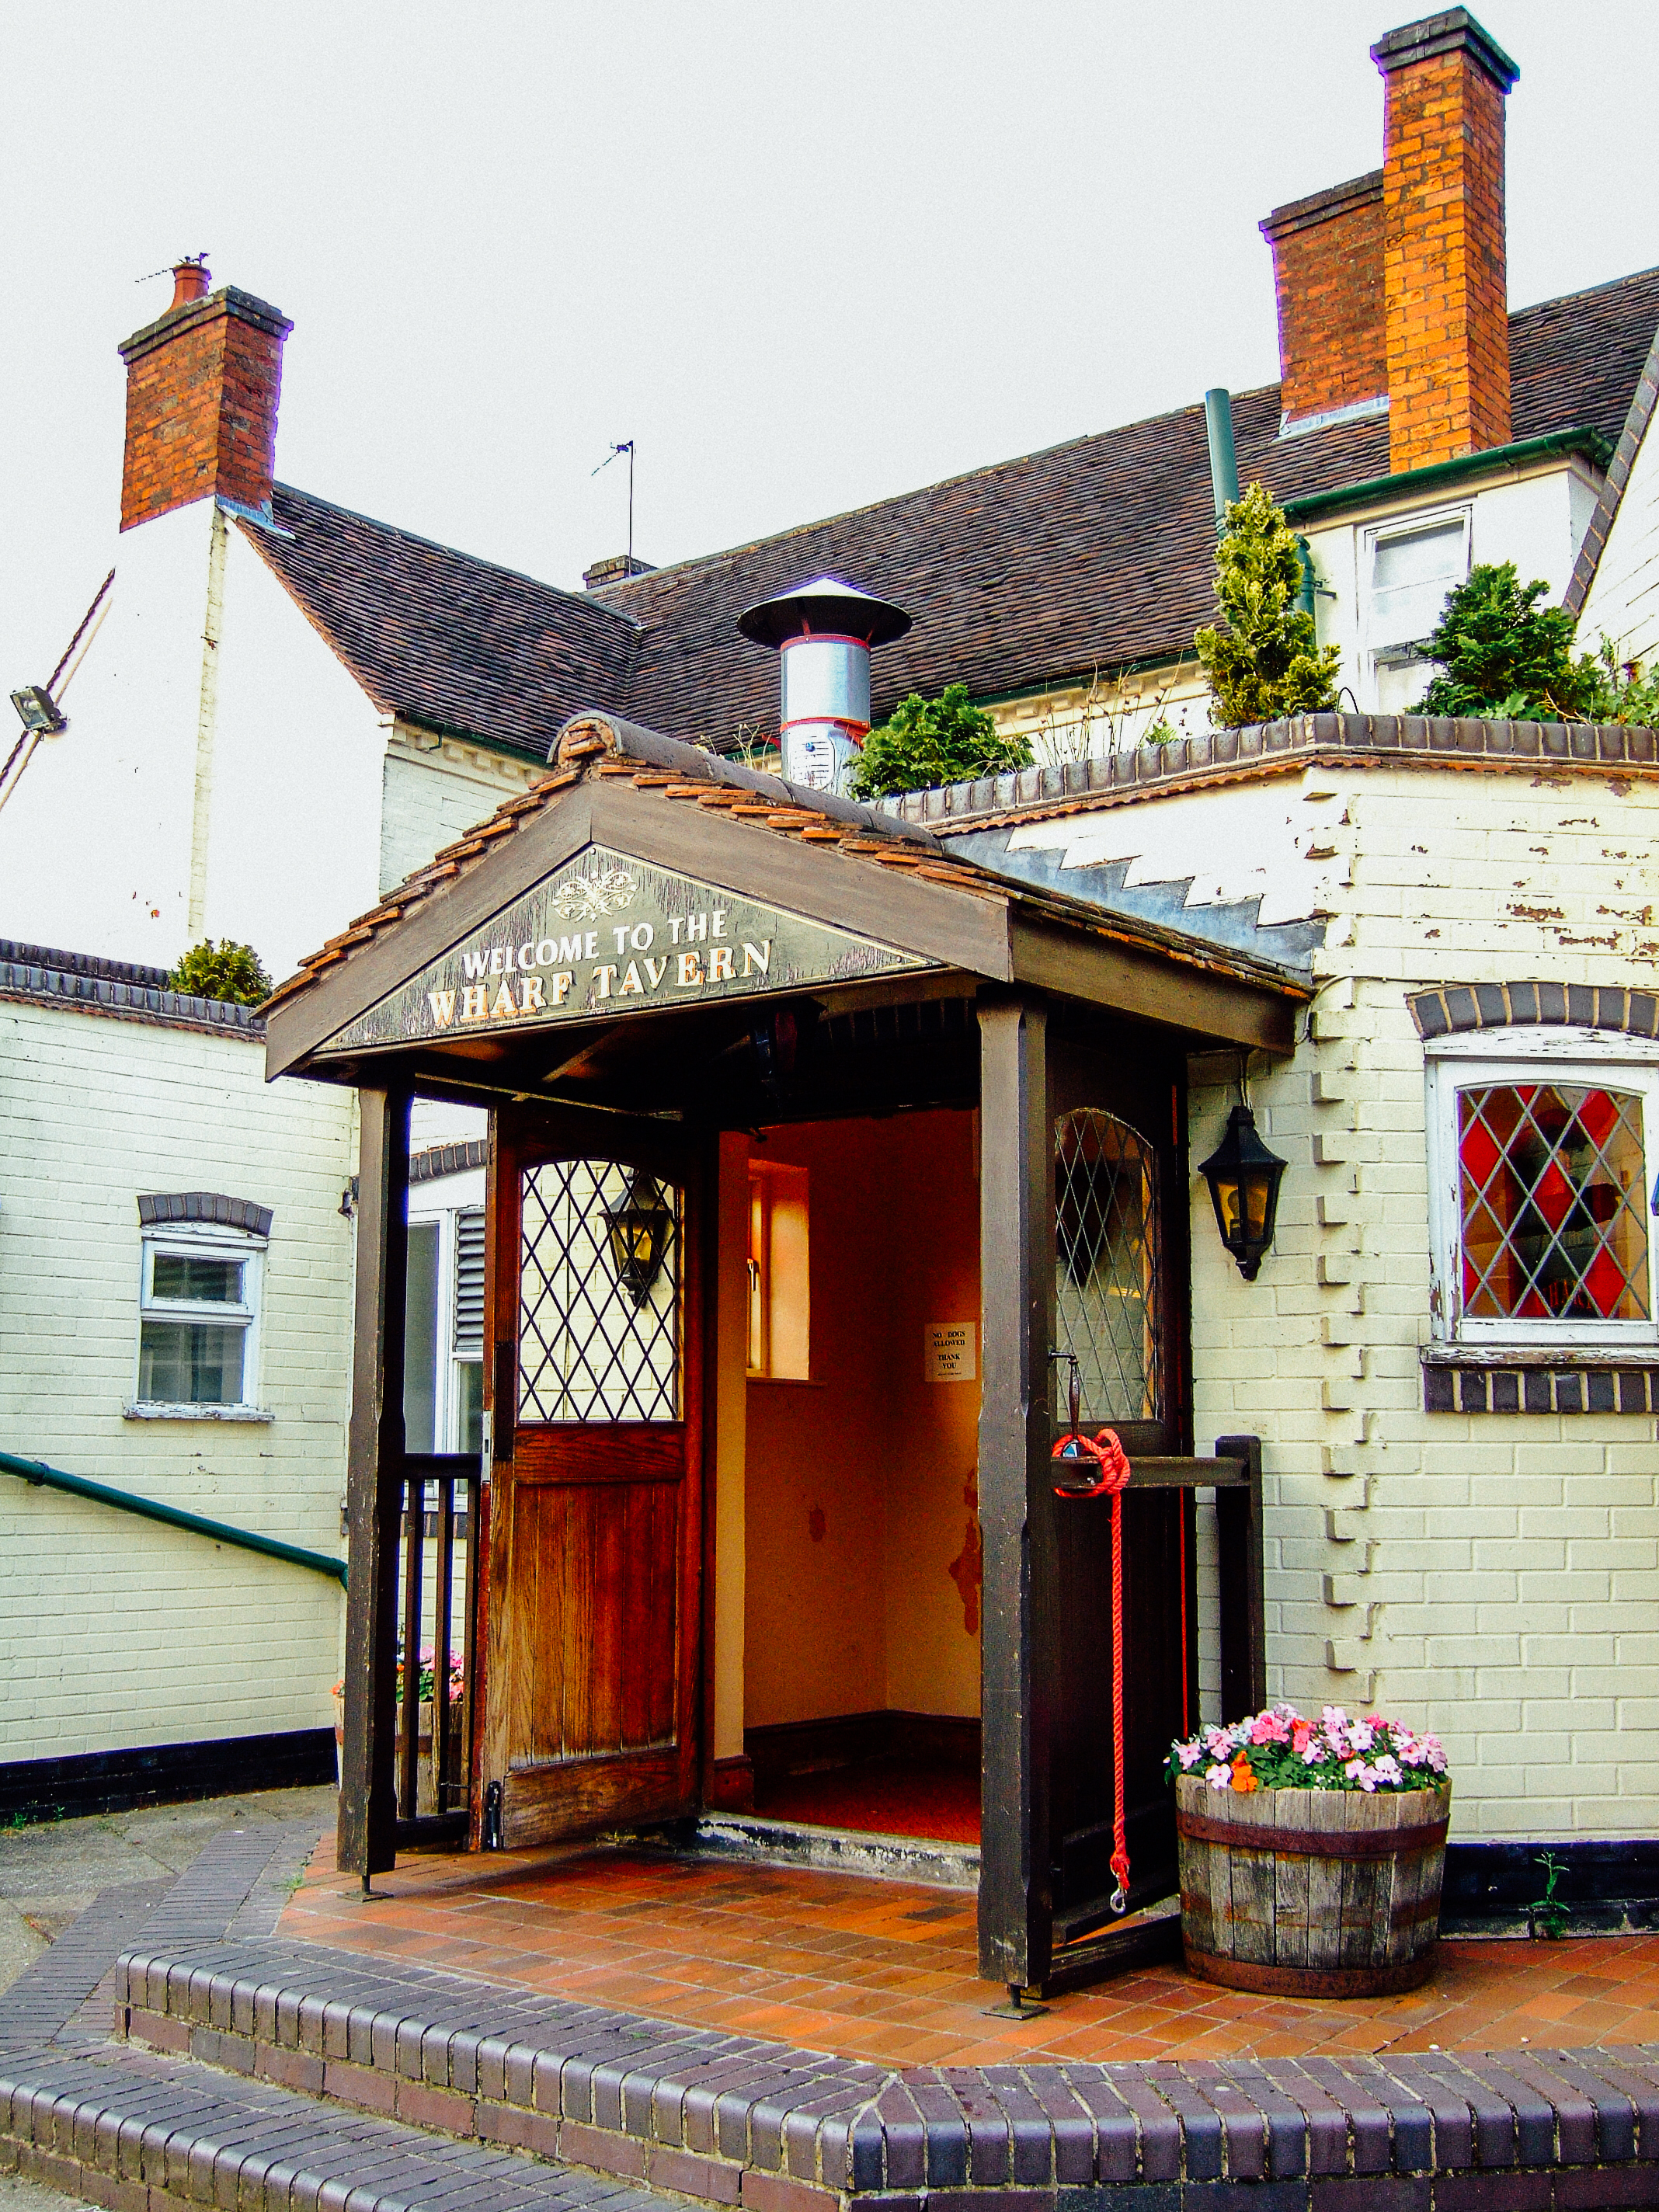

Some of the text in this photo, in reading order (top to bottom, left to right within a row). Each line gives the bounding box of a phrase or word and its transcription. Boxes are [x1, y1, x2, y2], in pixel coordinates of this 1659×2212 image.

[427, 939, 772, 1028] WHARF TAVERN
[462, 909, 728, 980] WELCOME TO THE
